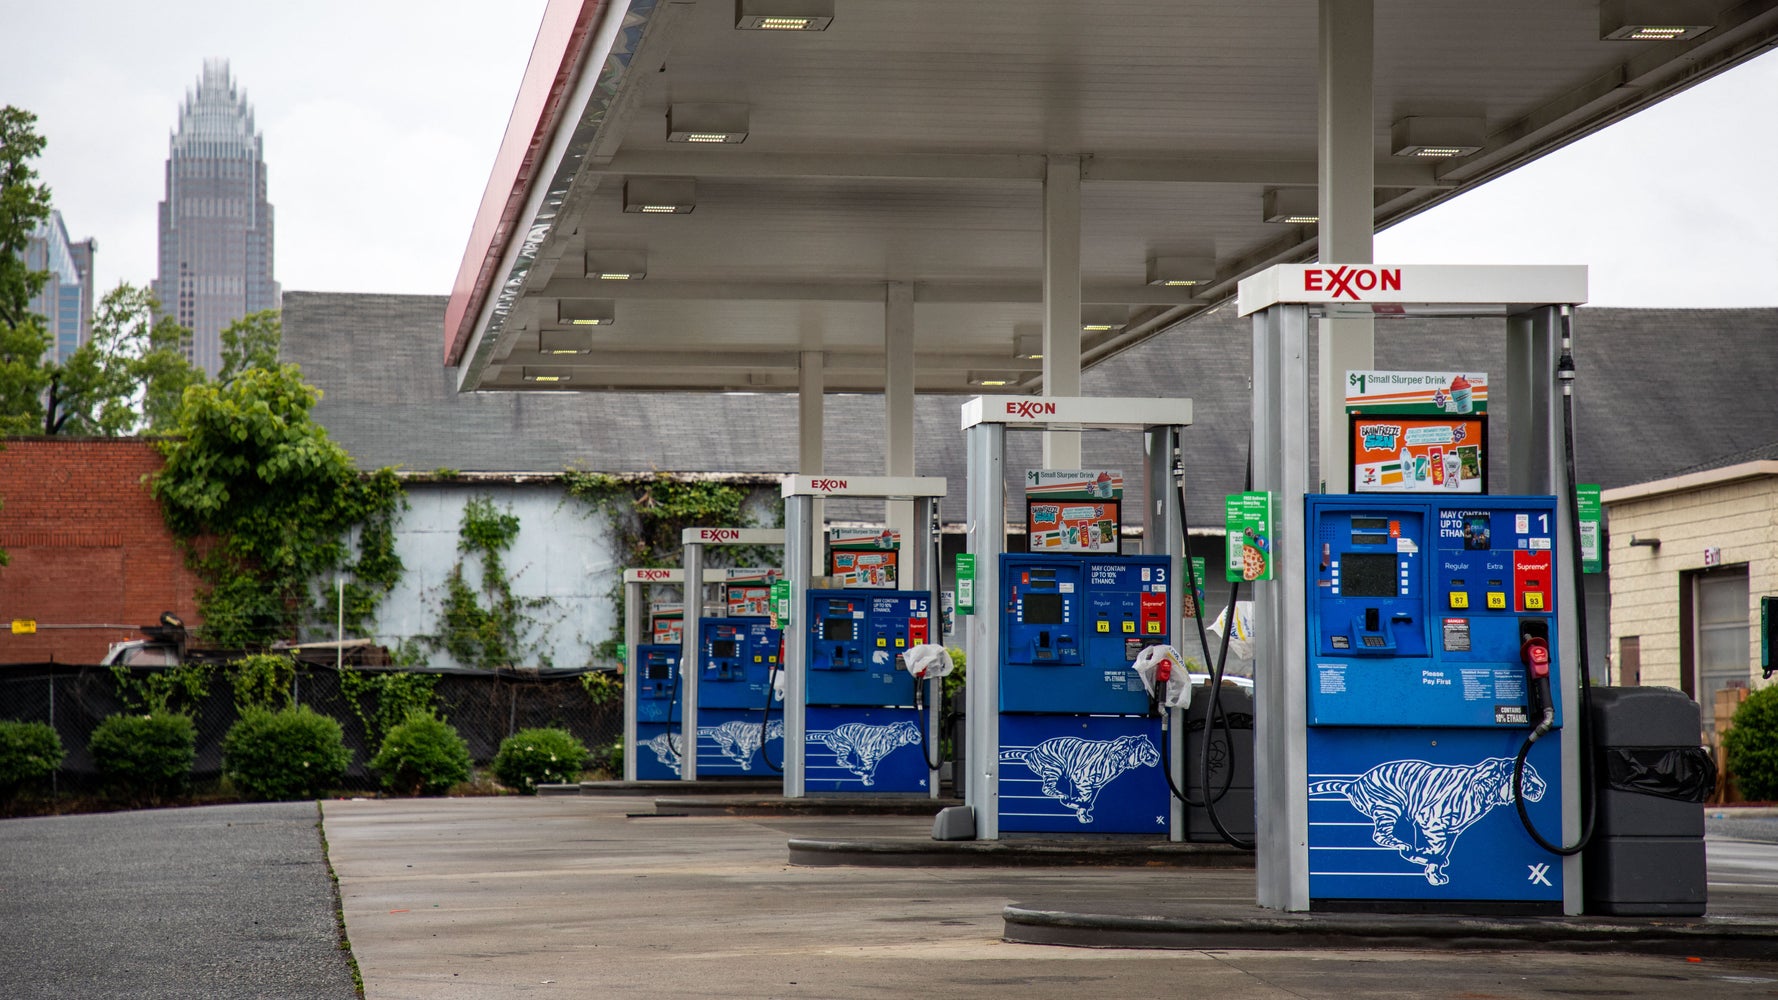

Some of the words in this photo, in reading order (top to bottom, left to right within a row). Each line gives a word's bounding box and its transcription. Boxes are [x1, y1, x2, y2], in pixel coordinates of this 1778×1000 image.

[1305, 265, 1401, 300] EXXON
[1350, 374, 1366, 394] $1
[1368, 374, 1390, 383] Small
[1425, 375, 1446, 384] Drink
[1006, 400, 1056, 418] EXXON
[1028, 470, 1039, 485] $1
[811, 478, 847, 492] EXXON
[1440, 511, 1456, 519] MAY
[1440, 520, 1451, 528] UP
[1451, 520, 1462, 528] TO
[1538, 514, 1548, 534] 1
[700, 528, 739, 542] EXXON
[1705, 549, 1719, 565] Exit
[1445, 563, 1469, 571] Regular
[637, 570, 670, 581] EXXON
[1156, 568, 1165, 582] 3
[920, 601, 926, 610] 5
[1496, 714, 1506, 723] 10%
[1507, 714, 1528, 723] ETHANOL
